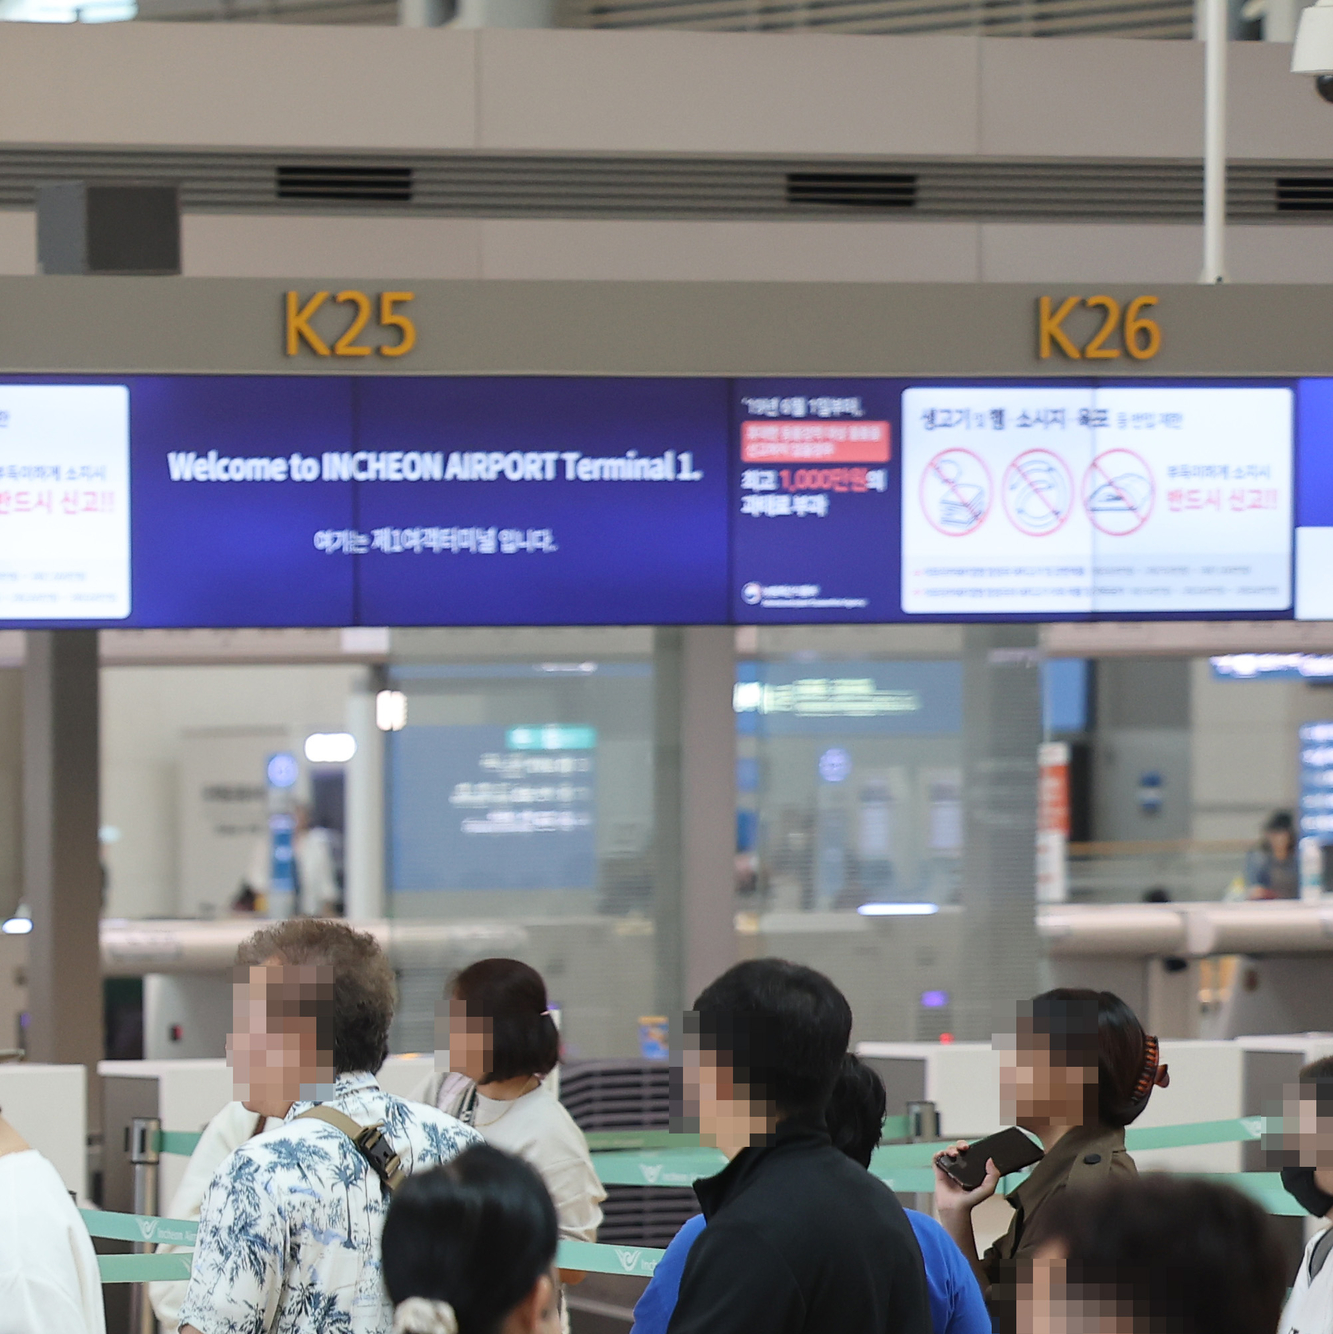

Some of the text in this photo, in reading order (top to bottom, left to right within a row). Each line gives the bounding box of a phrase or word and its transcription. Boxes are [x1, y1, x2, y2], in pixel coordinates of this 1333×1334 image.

[285, 290, 417, 356] K25
[1037, 295, 1162, 360] K26
[167, 450, 285, 481] Welcome
[289, 453, 318, 481] to
[322, 451, 442, 481] INCHEON
[444, 451, 560, 481] AIRPORT
[563, 449, 674, 481] Terminal
